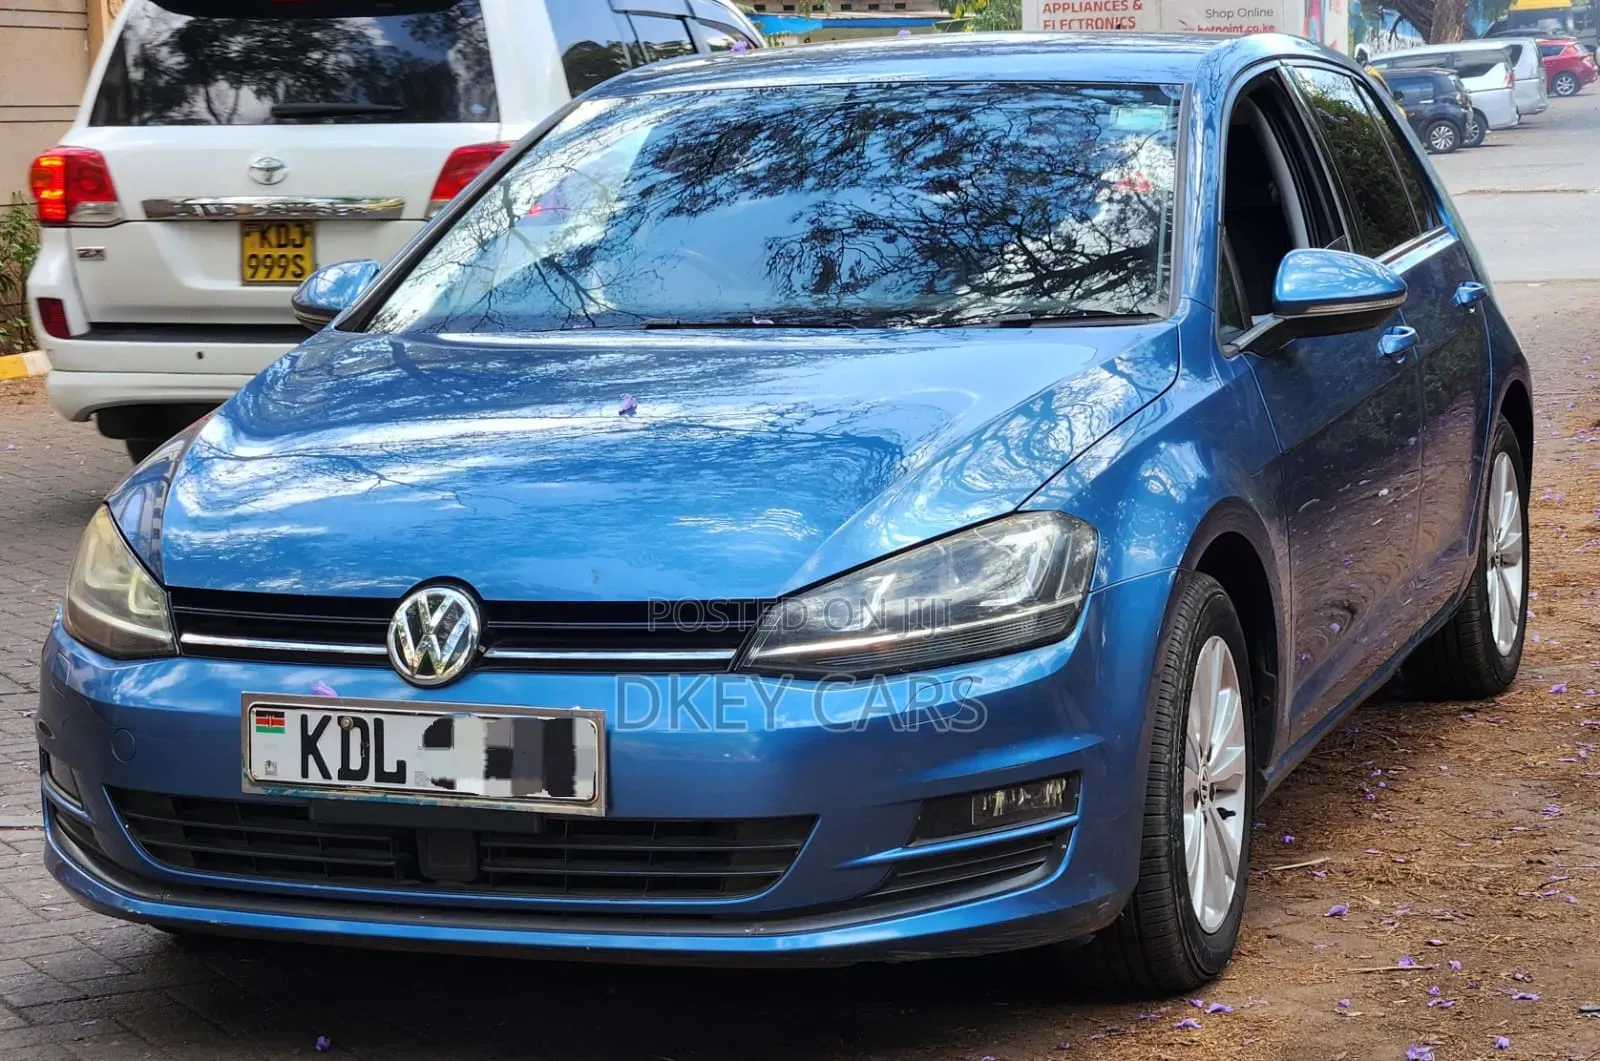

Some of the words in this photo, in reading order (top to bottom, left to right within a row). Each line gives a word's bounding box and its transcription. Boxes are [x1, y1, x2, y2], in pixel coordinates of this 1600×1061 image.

[1043, 0, 1128, 14] APPLIANCES
[1132, 0, 1143, 11] &
[1205, 8, 1234, 20] Shop
[1237, 7, 1274, 18] Online
[260, 223, 305, 249] KDJ
[247, 253, 306, 279] 999S
[299, 712, 407, 784] KDL
